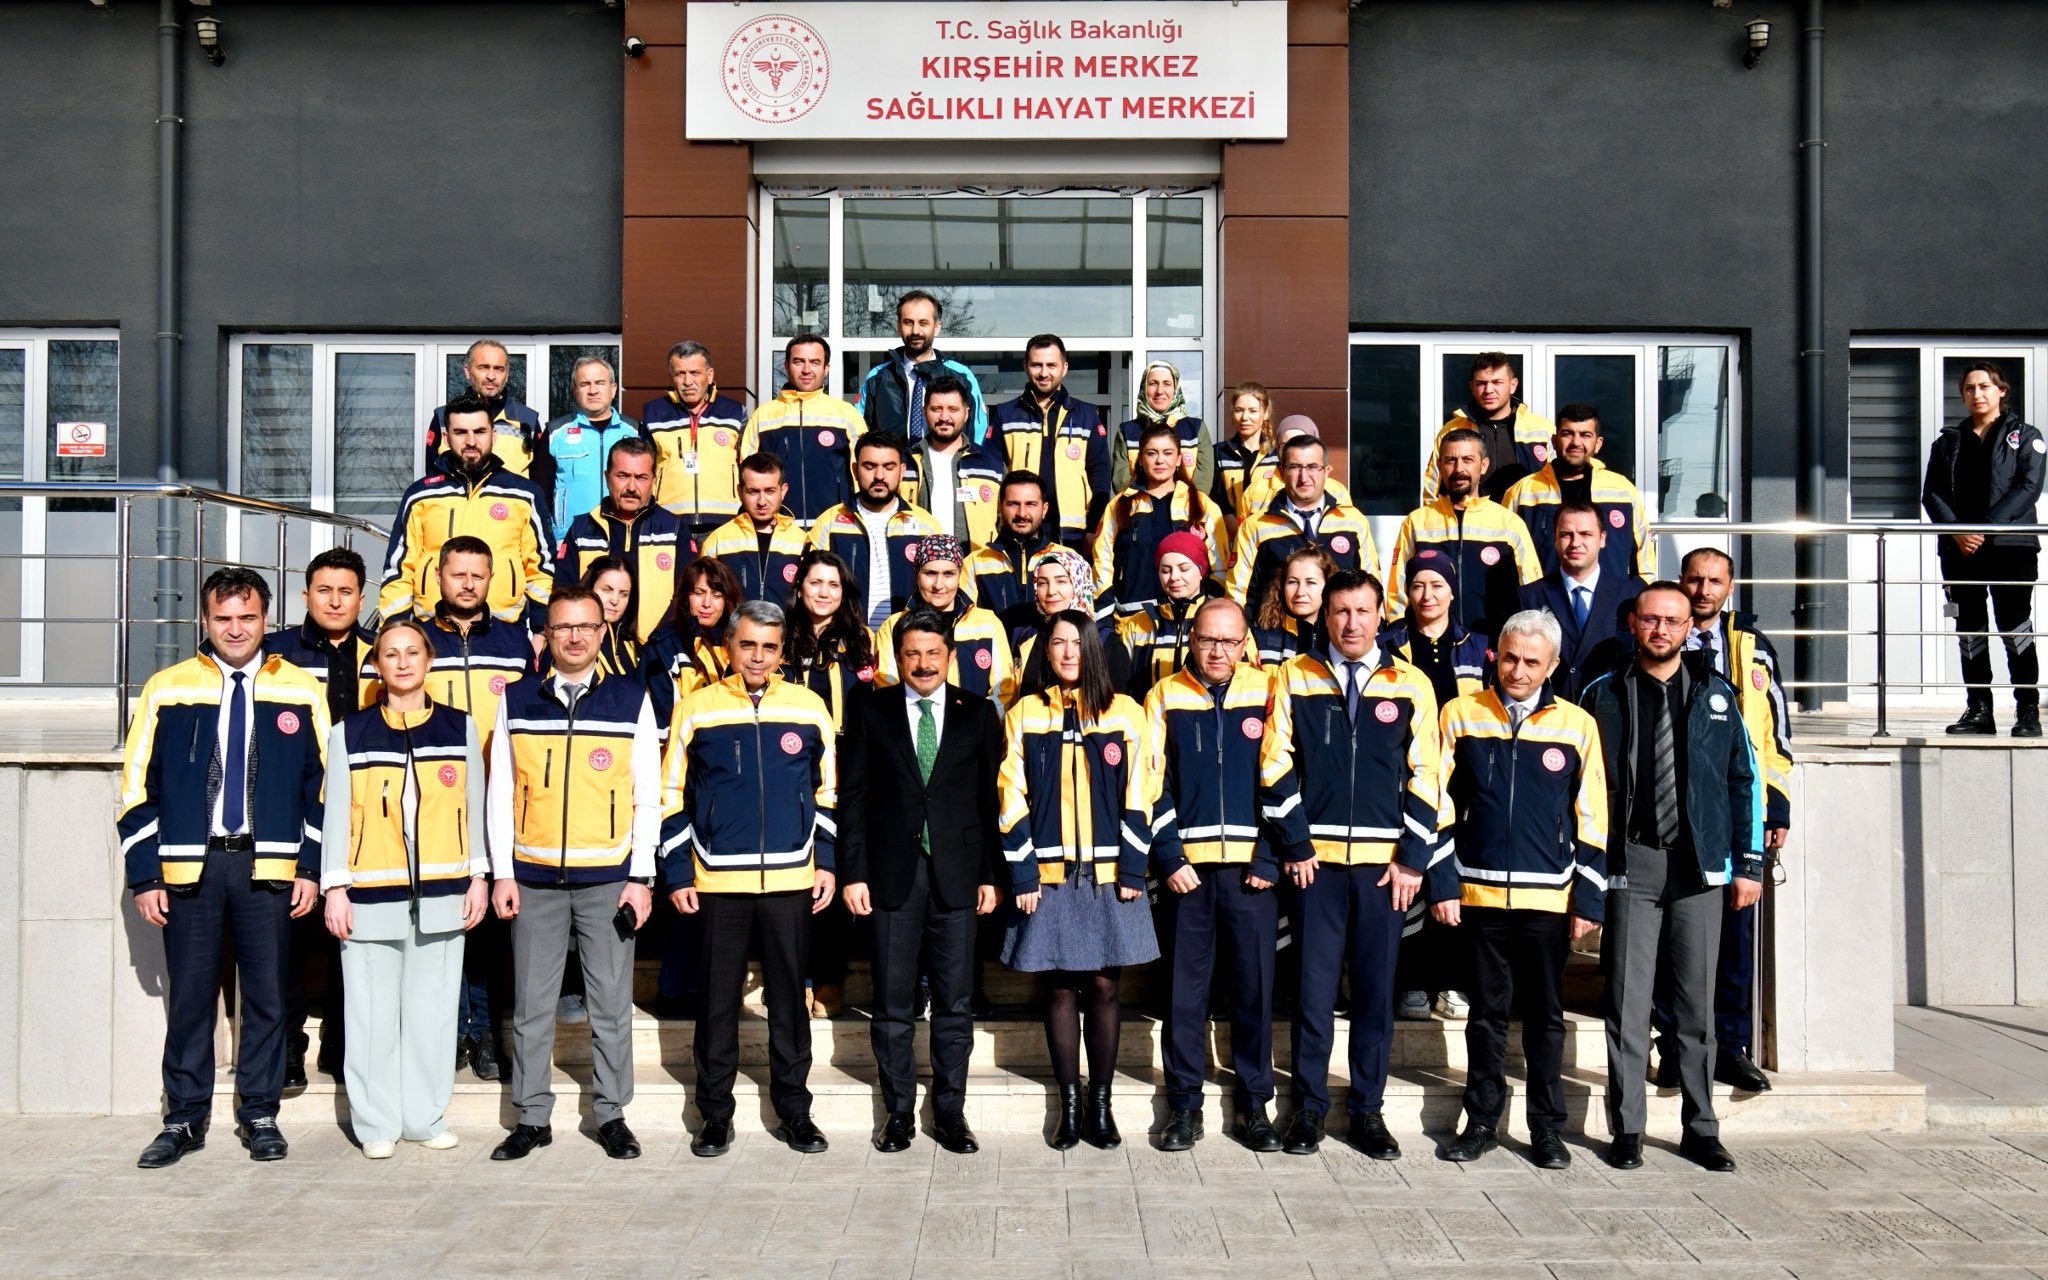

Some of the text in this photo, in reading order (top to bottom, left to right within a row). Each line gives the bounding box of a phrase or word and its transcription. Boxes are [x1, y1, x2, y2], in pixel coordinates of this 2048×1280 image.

[936, 19, 1184, 44] T.C. Sağlık Bakanlığı
[742, 35, 783, 68] CUMHURİYETİ
[921, 51, 1199, 82] KIRŞEHİR MERKEZ
[866, 91, 1256, 120] SAĞLIKLI HAYAT MERKEZİ
